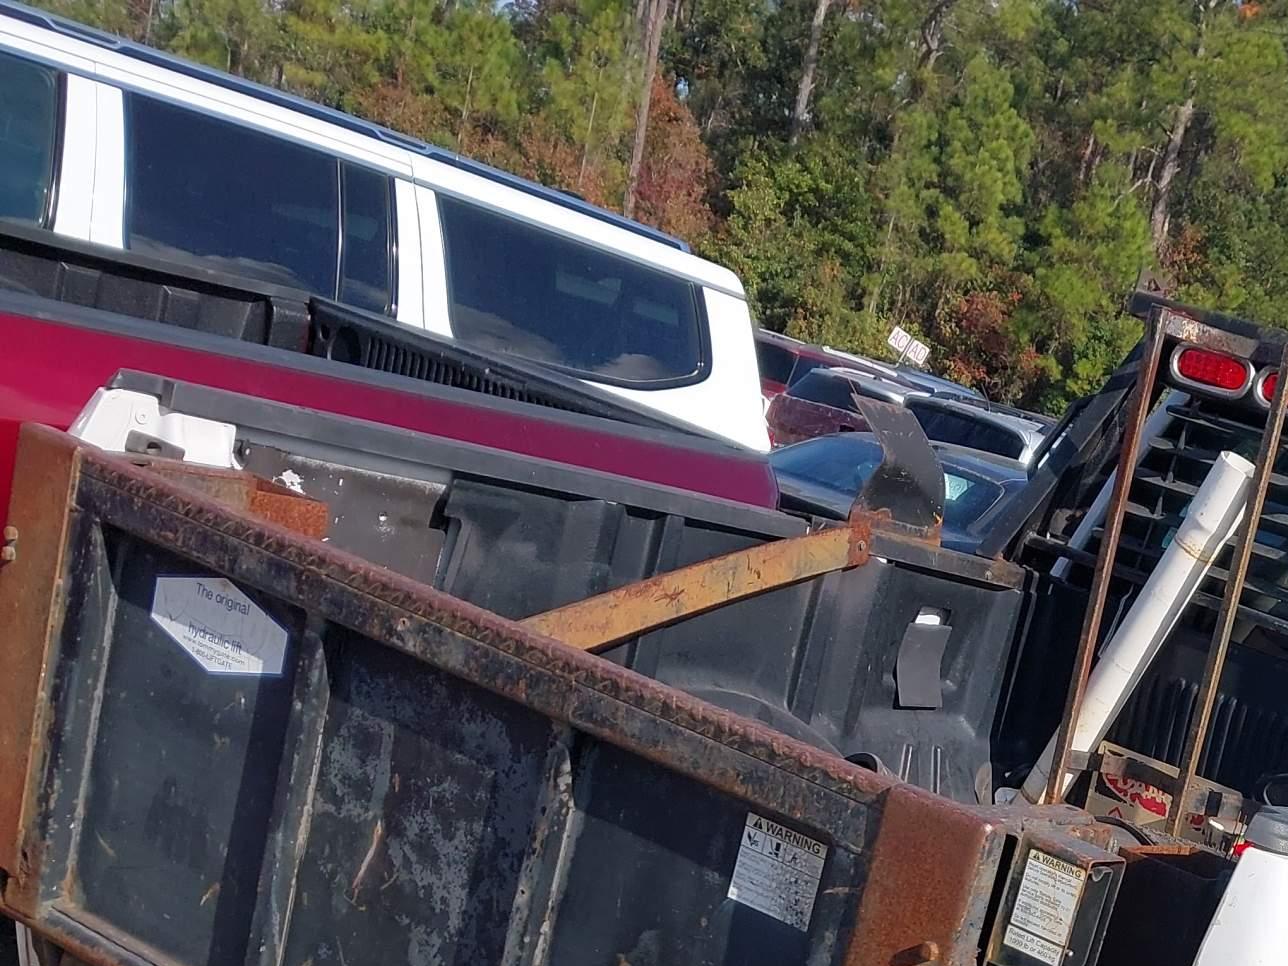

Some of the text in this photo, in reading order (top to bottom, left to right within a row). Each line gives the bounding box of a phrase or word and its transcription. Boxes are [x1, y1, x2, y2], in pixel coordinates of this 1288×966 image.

[196, 583, 251, 615] The original
[188, 621, 242, 655] hydraulic lift
[766, 821, 821, 855] WARNING
[1042, 855, 1082, 878] WARNING
